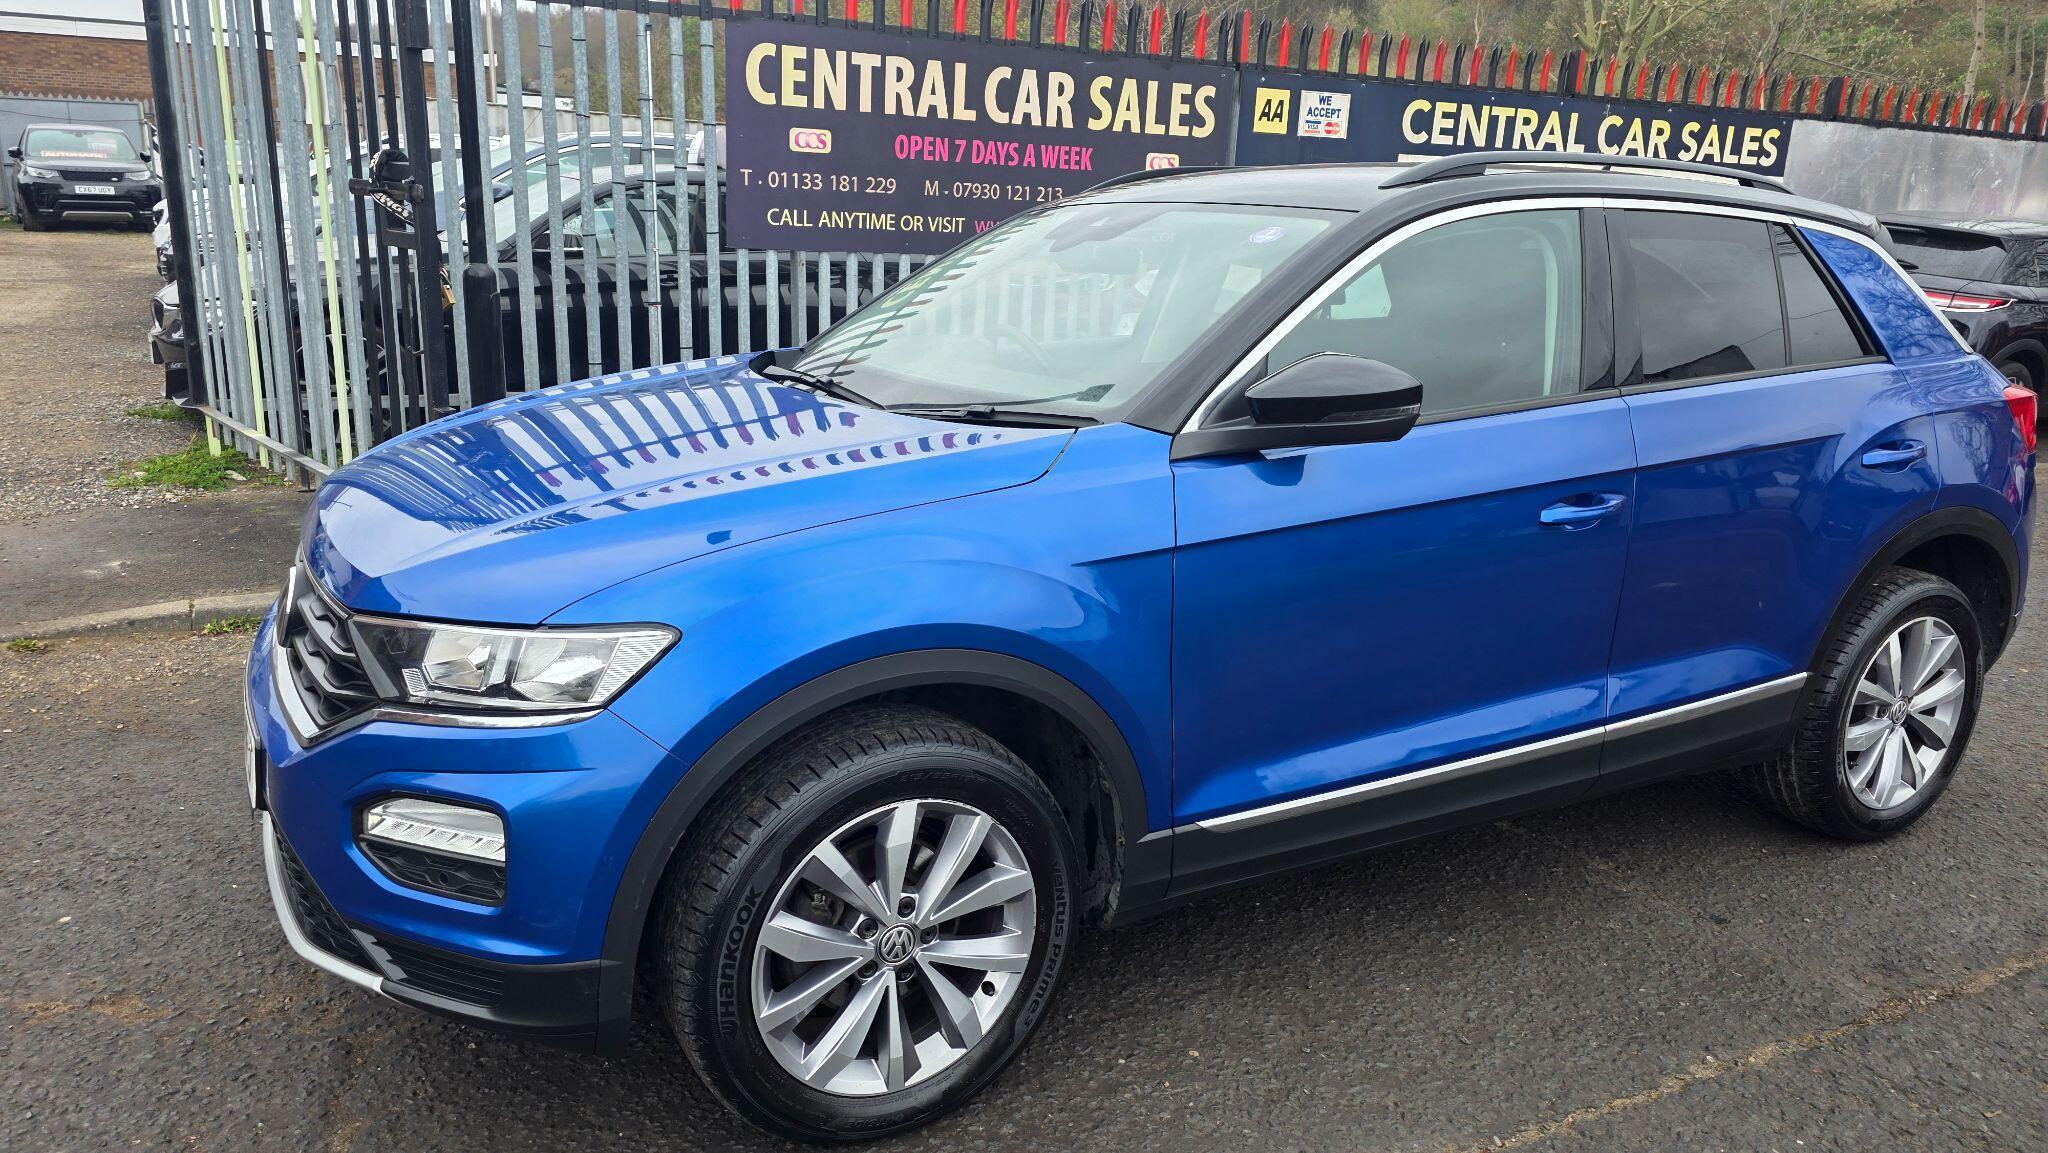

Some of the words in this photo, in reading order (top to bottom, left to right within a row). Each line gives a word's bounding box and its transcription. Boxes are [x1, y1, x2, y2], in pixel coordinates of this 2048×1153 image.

[745, 42, 977, 121] CENTRAL
[984, 66, 1075, 129] CAR
[1087, 75, 1217, 138] SALES
[1319, 95, 1333, 106] WE
[1258, 99, 1285, 122] AA
[1306, 106, 1342, 119] ACCEPT
[1402, 98, 1586, 153] CENTRAL
[1597, 115, 1672, 160] CAR
[1678, 121, 1781, 168] SALES
[895, 134, 949, 162] OPEN
[954, 139, 967, 163] 7
[971, 140, 1019, 167] DAYS
[1023, 144, 1037, 168] A
[1040, 145, 1094, 171] WEEK
[768, 171, 823, 190] 01133
[830, 174, 859, 192] 181
[865, 177, 897, 194] 229
[953, 182, 1000, 200] 07930
[1006, 185, 1030, 201] 121
[1036, 187, 1063, 202] 213
[767, 208, 813, 227] CALL
[818, 211, 896, 231] ANYTIME
[900, 215, 923, 232] OR
[928, 216, 966, 233] VISIT
